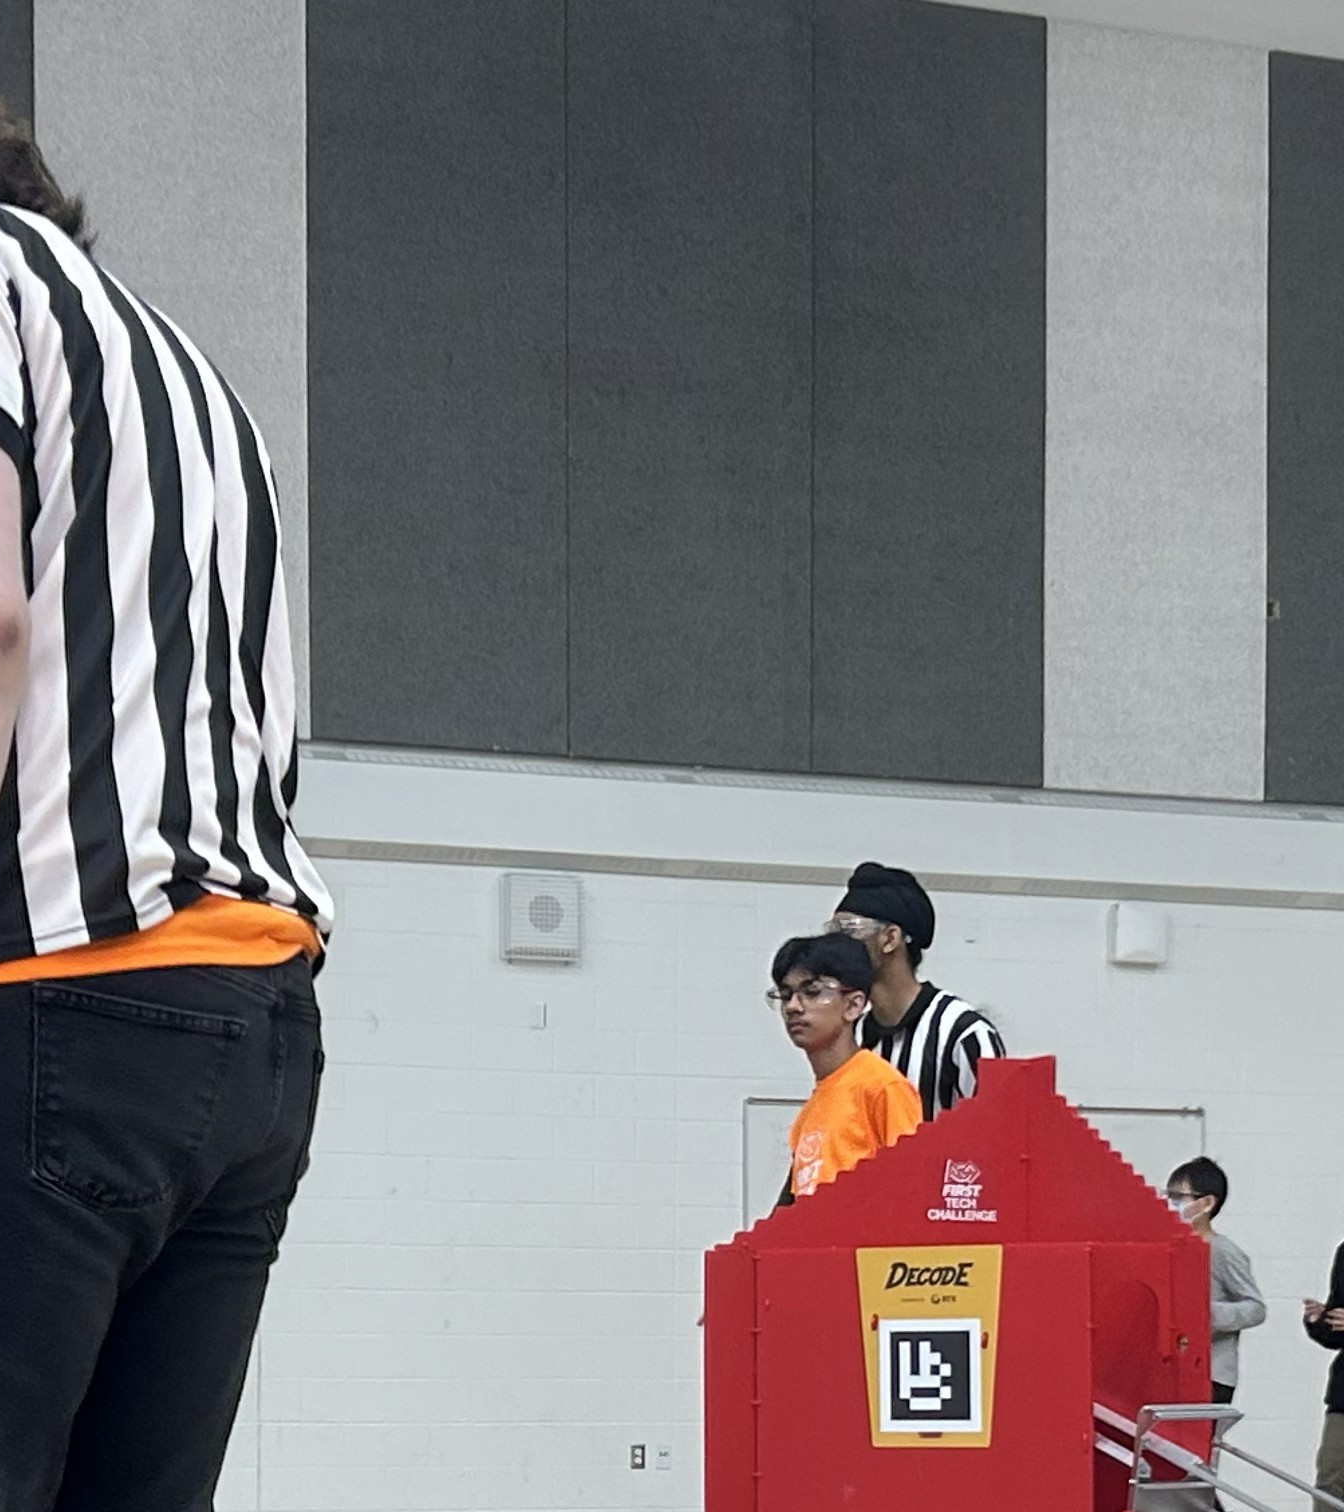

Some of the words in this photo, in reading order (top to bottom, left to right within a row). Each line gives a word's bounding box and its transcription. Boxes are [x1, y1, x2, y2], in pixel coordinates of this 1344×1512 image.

[942, 1184, 983, 1197] FIRST
[945, 1197, 977, 1209] TECH
[927, 1209, 997, 1222] CHALLENGE
[885, 1262, 974, 1290] DECODE
